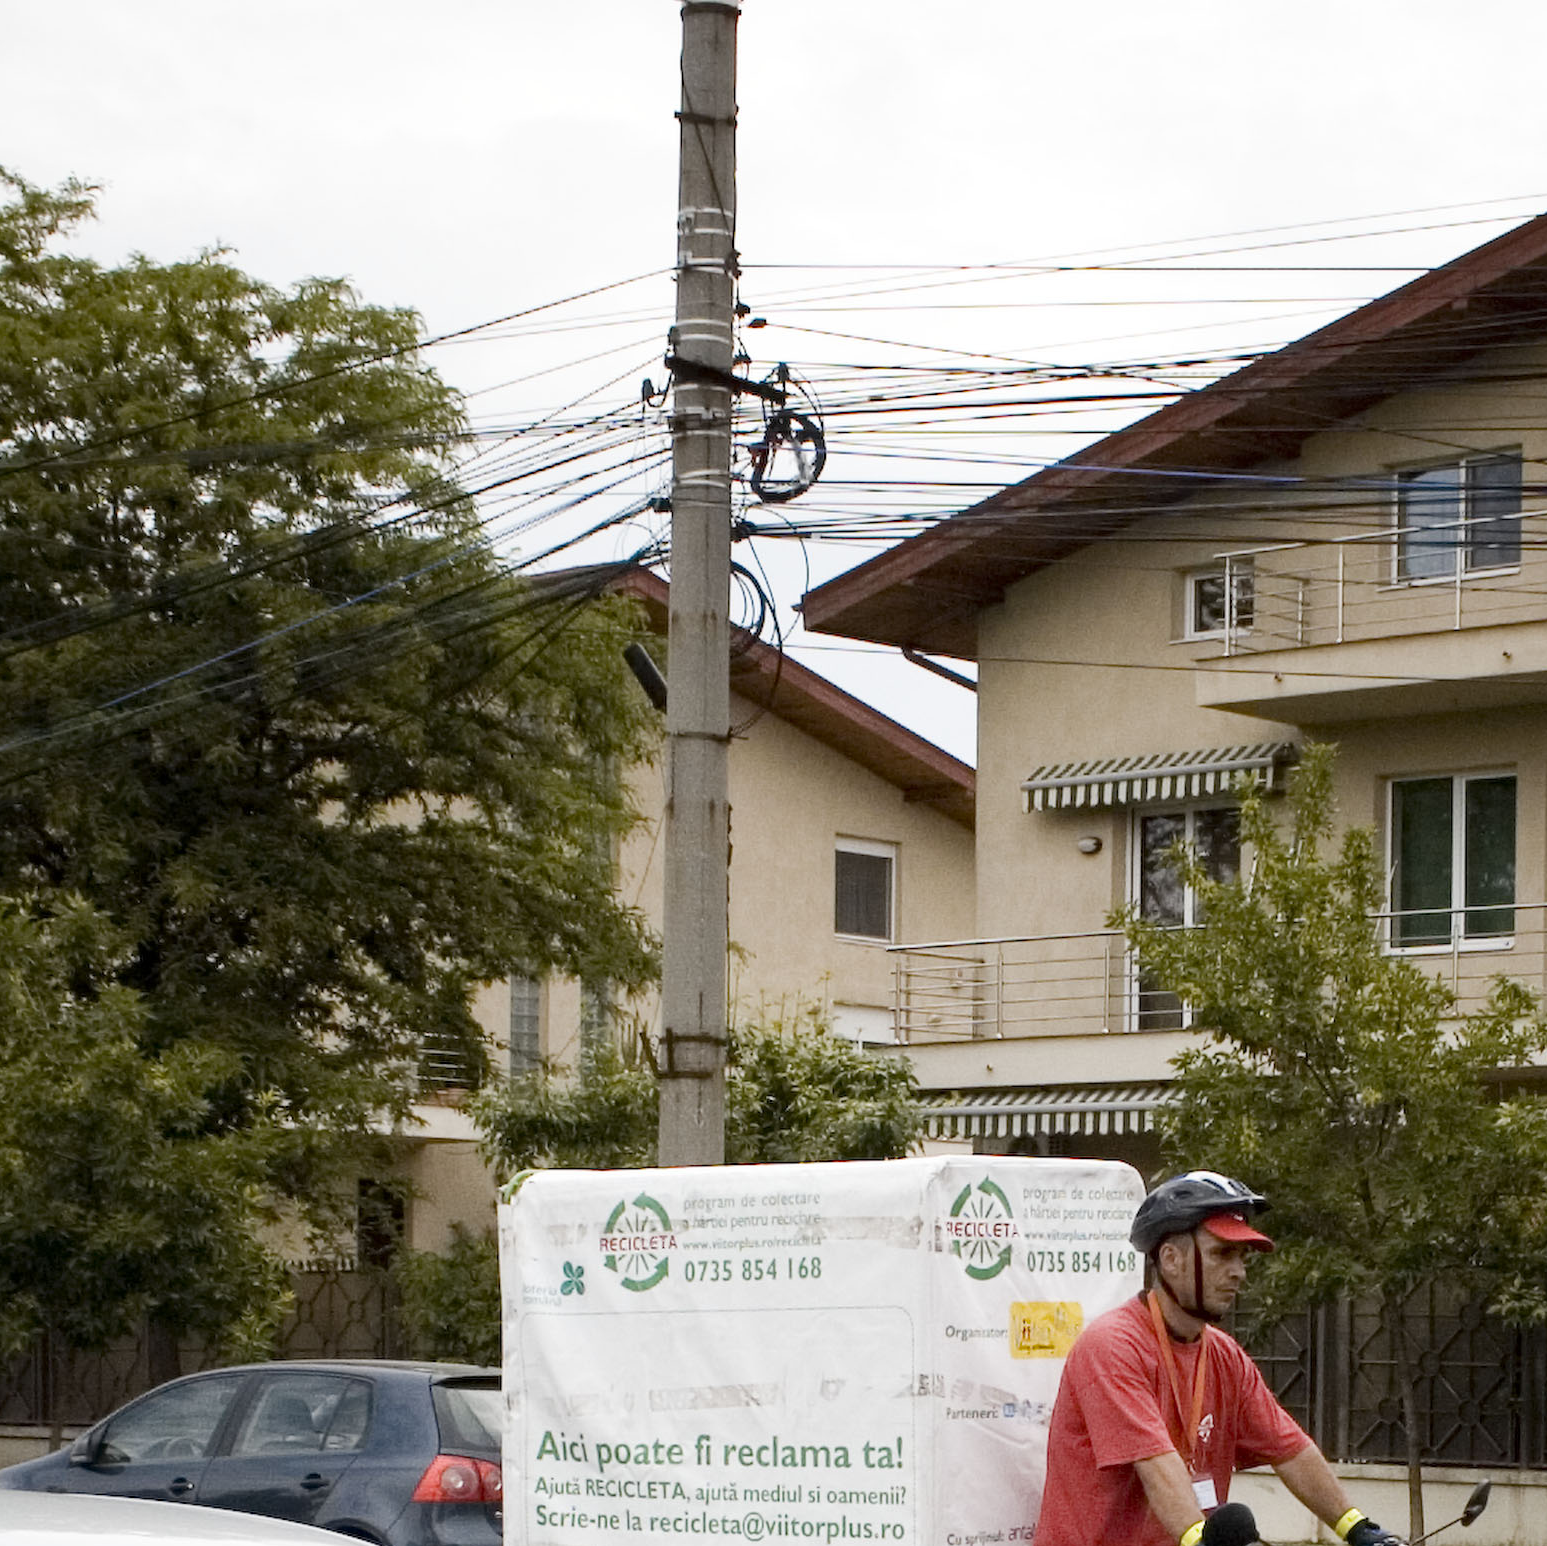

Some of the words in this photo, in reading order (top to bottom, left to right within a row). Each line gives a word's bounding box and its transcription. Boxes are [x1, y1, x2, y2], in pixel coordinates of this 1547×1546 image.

[684, 1196, 735, 1213] program
[741, 1193, 756, 1207] de
[762, 1192, 821, 1206] colectare
[1071, 1187, 1085, 1201] de
[946, 1222, 1020, 1239] RECICLETA
[600, 1234, 678, 1252] RECICLETA
[684, 1259, 733, 1283] 0735
[741, 1258, 777, 1281] 854
[786, 1256, 822, 1280] 168
[1027, 1251, 1065, 1273] 0735
[1071, 1251, 1101, 1273] 854
[1108, 1251, 1136, 1273] 168
[536, 1430, 589, 1462] Aici
[596, 1438, 683, 1473] poate
[695, 1434, 711, 1465] fi
[724, 1436, 852, 1468] reclama
[862, 1436, 903, 1469] ta!
[586, 1478, 691, 1503] RECICLETA,
[695, 1482, 738, 1505] ajută
[744, 1484, 802, 1503] mediul
[536, 1504, 620, 1530] Scrie-ne
[626, 1509, 642, 1531] la
[650, 1511, 905, 1545] recicleta@viitorplus.ro
